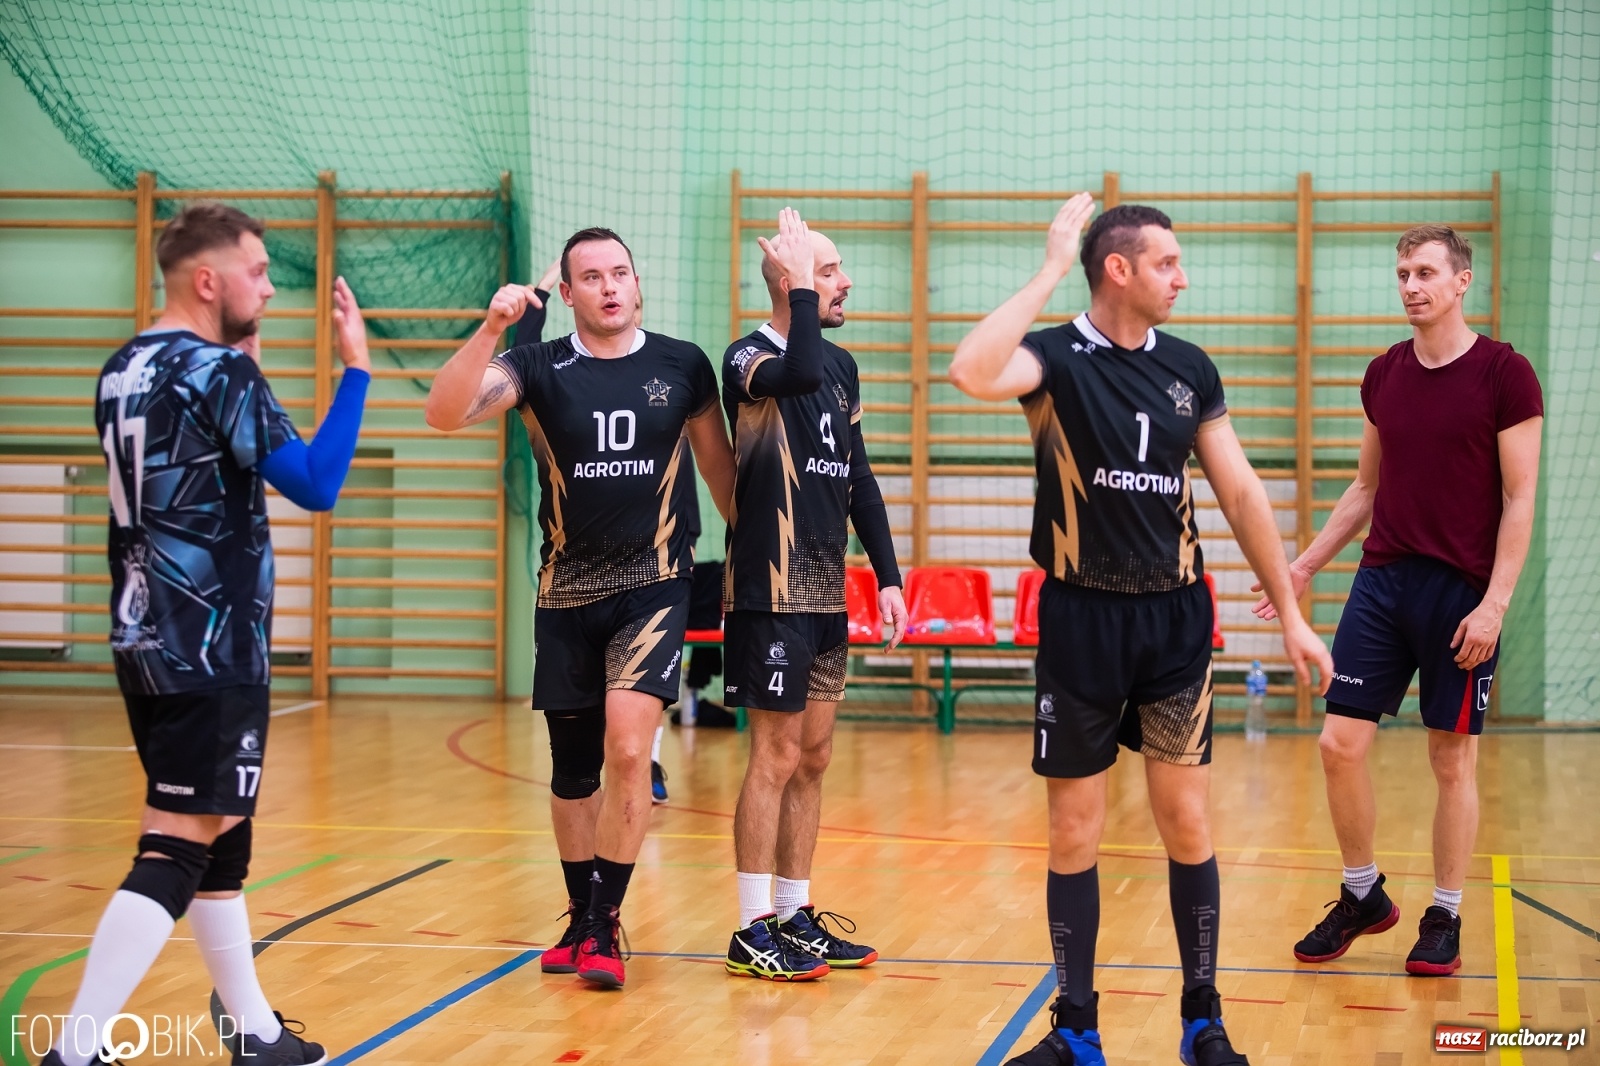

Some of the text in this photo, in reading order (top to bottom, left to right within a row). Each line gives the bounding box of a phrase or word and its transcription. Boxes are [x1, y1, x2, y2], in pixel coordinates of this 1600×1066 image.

[593, 409, 636, 453] 10
[819, 411, 836, 454] 4
[1134, 411, 1150, 463] 1
[104, 416, 147, 528] 17
[573, 459, 655, 478] AGROTIM
[1093, 467, 1179, 494] AGROTIM
[768, 671, 784, 697] 4
[1040, 728, 1048, 759] 1
[235, 765, 262, 798] 17
